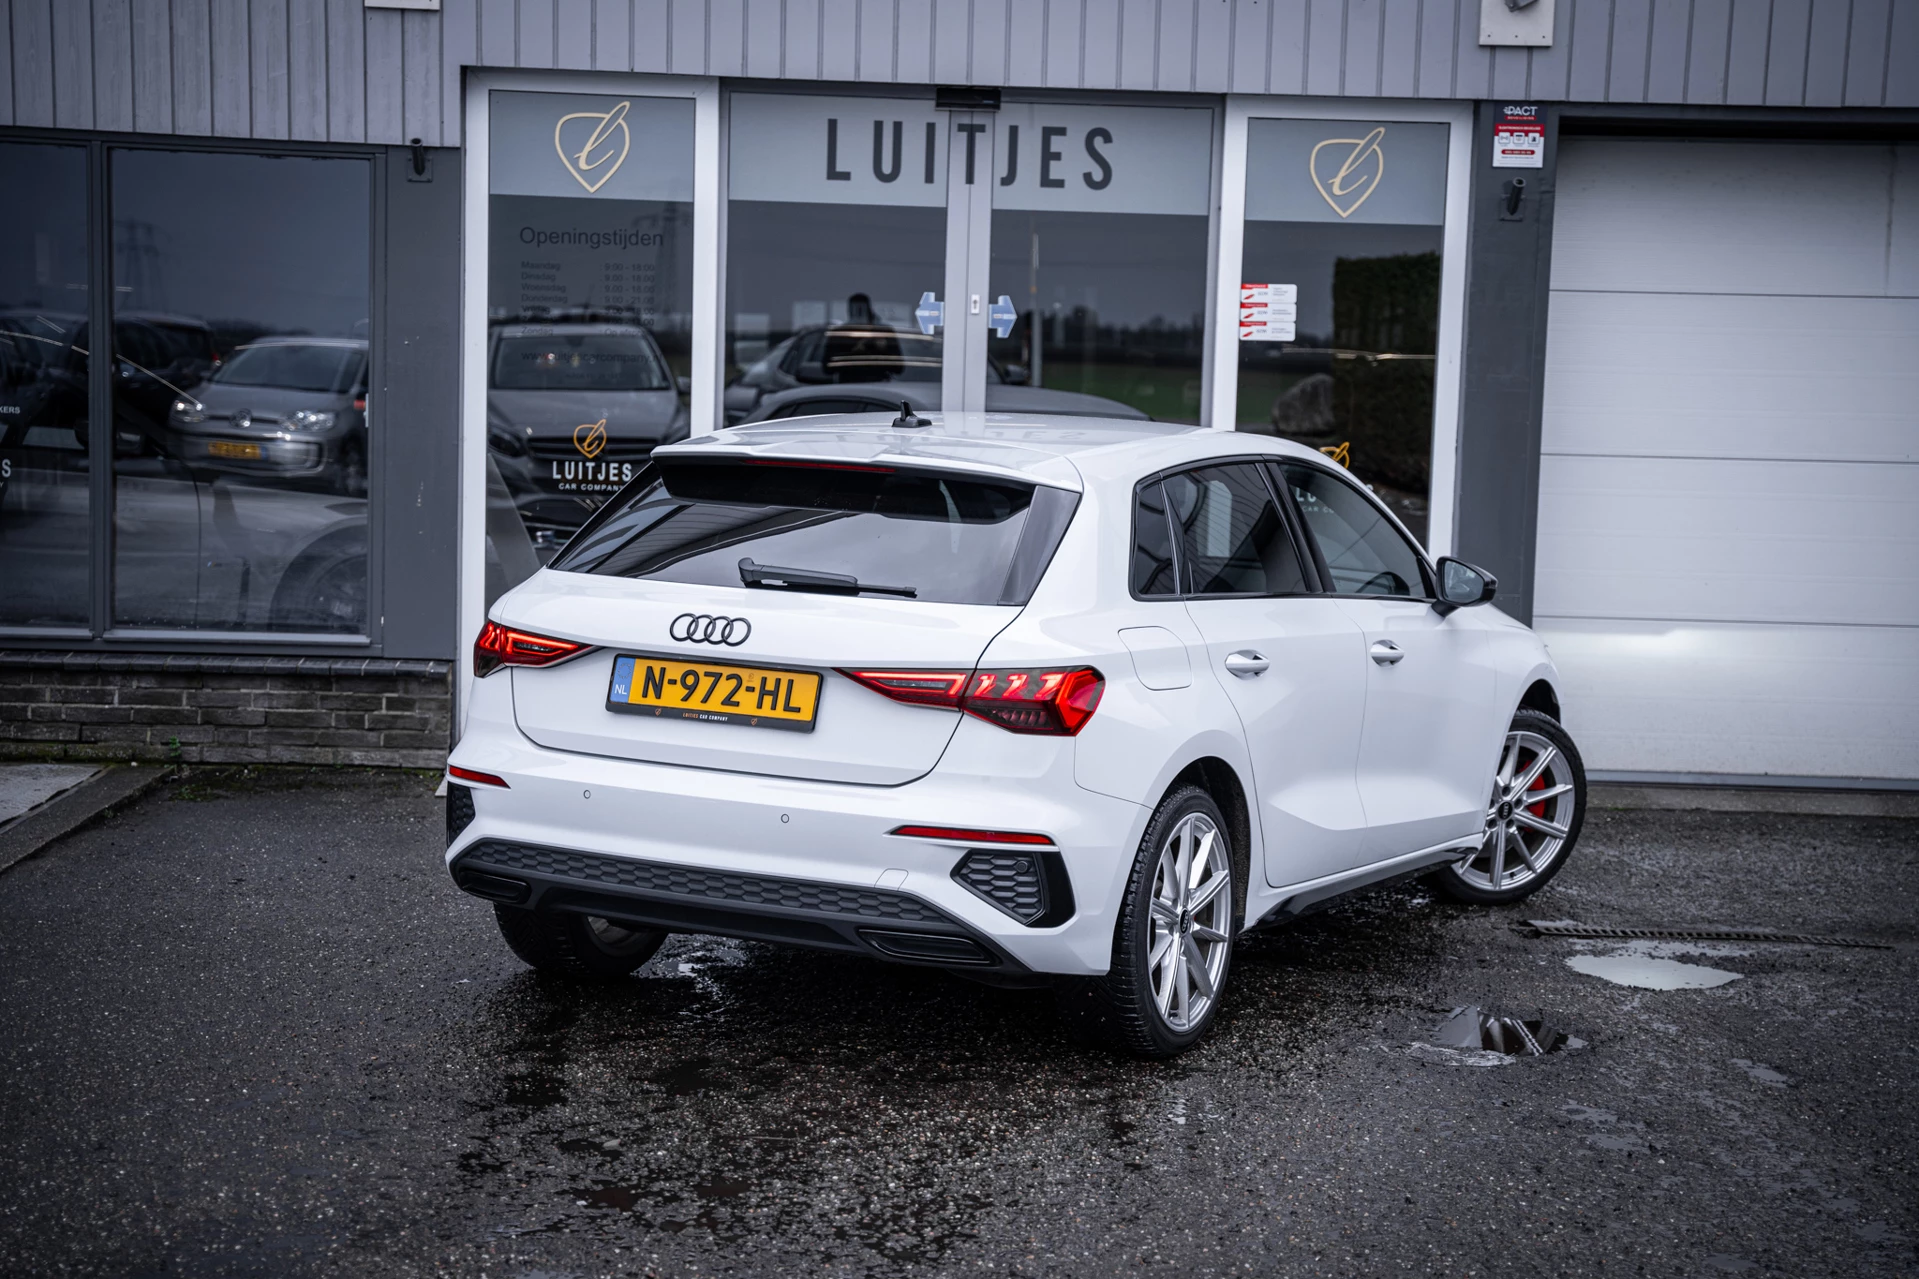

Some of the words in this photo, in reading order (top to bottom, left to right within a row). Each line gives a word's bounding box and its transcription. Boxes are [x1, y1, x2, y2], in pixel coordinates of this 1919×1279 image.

[826, 118, 1113, 190] LUITJES
[519, 226, 664, 250] Openingstijden
[521, 261, 561, 271] Maandag
[521, 271, 556, 282] Dinsdag
[521, 326, 553, 337] Zondag
[553, 461, 632, 481] LUITJES
[614, 684, 628, 695] NL
[642, 665, 802, 713] N-972-HL
